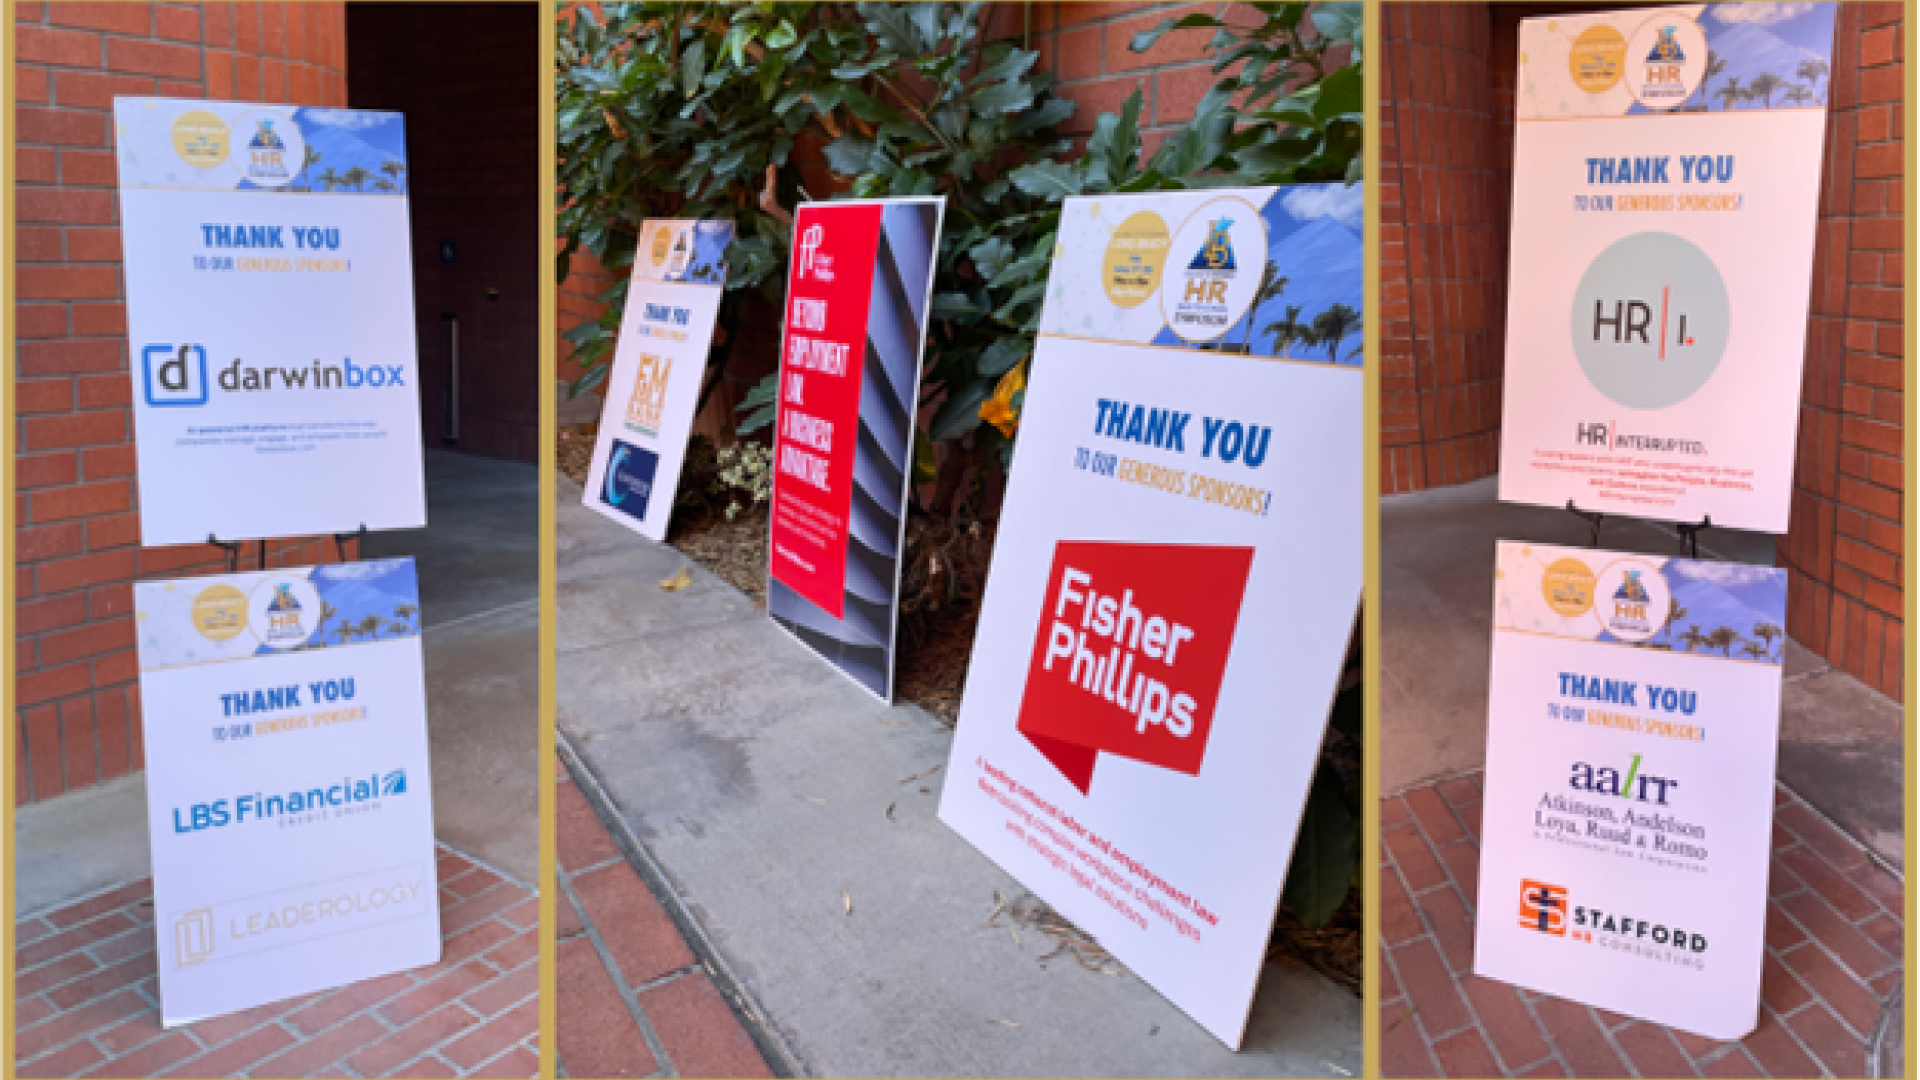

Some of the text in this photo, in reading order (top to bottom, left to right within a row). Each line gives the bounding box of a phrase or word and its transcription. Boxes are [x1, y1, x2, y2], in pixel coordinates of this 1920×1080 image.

[1584, 153, 1736, 185] THANK YOU
[200, 223, 342, 251] THANK YOU
[1184, 279, 1228, 304] HR
[1593, 297, 1653, 346] HR
[217, 355, 406, 392] darwinbox
[1093, 397, 1273, 469] THANK YOU
[1575, 420, 1608, 446] HR
[1074, 444, 1090, 470] TO
[1091, 450, 1118, 478] OUR
[1117, 456, 1187, 495] GENEROUS
[1054, 564, 1196, 667] Fisher
[218, 675, 356, 719] THANK YOU
[1042, 618, 1198, 739] Phillips
[1556, 671, 1699, 716] THANK YOU
[172, 774, 380, 835] LBS Financial
[1569, 752, 1680, 808] aalrr
[230, 879, 422, 941] LEADEROLOGY
[1572, 905, 1708, 954] STAFFORD
